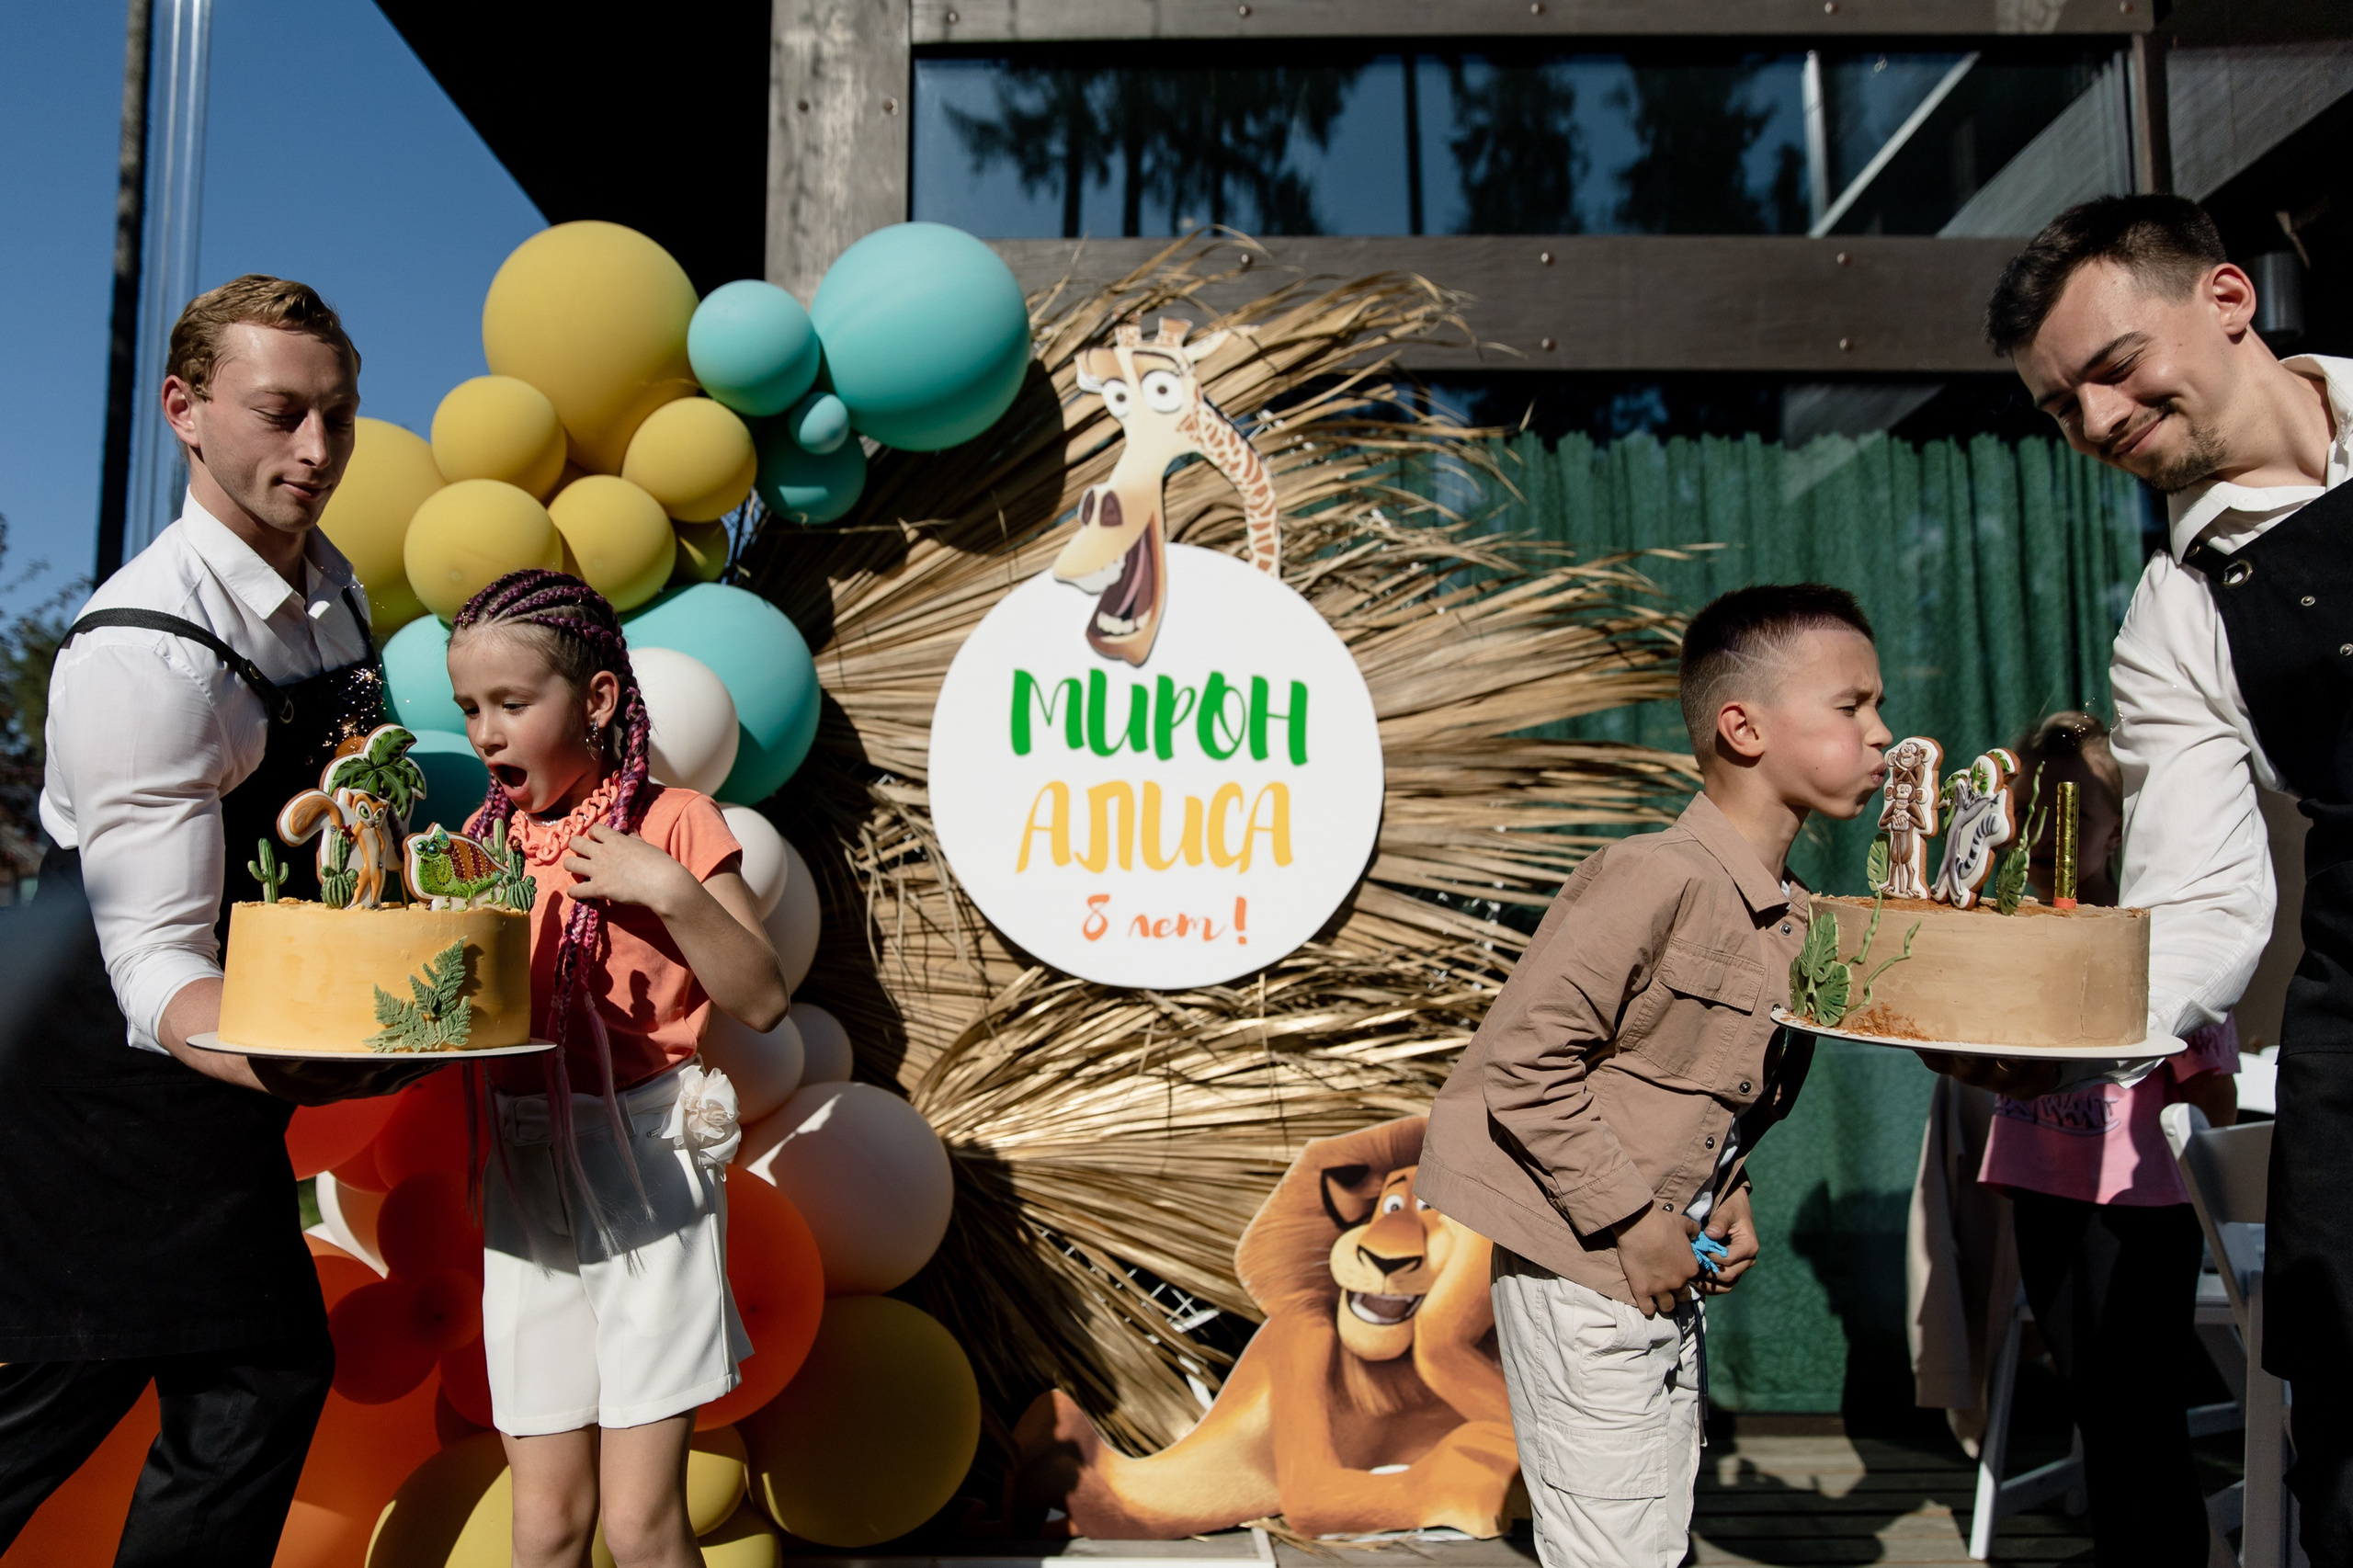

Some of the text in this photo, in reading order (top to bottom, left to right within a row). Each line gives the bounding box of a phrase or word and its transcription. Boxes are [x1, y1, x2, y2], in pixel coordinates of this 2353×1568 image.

[1010, 668, 1308, 767] МИРОН
[1016, 780, 1294, 874] АЛИСА
[1082, 893, 1110, 942] 8
